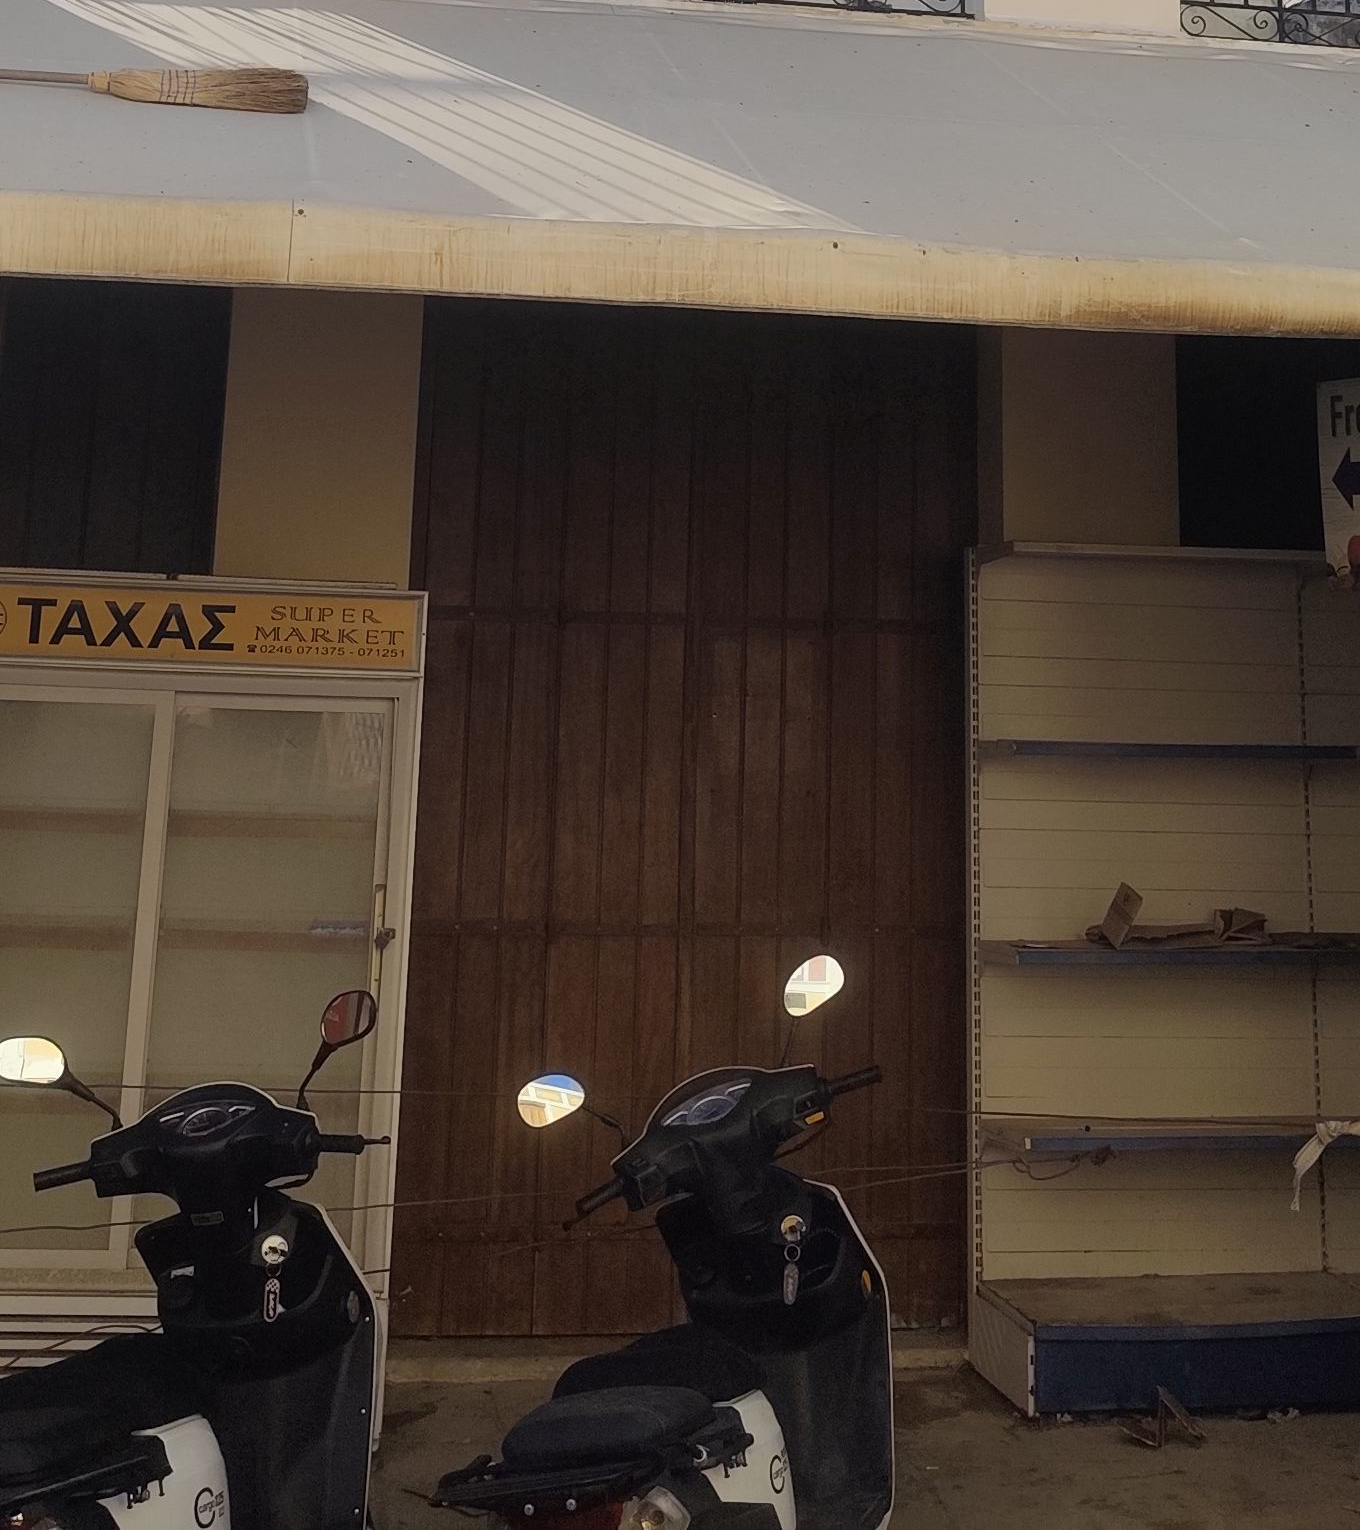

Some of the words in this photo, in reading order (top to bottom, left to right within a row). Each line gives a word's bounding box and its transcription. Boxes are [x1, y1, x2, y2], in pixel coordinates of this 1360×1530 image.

[270, 606, 382, 623] SUPER
[17, 597, 236, 651] ΤΑΧΑΣ
[255, 626, 404, 645] MARKET
[260, 644, 292, 655] 0246
[296, 645, 346, 657] 071375
[357, 647, 406, 658] 071251
